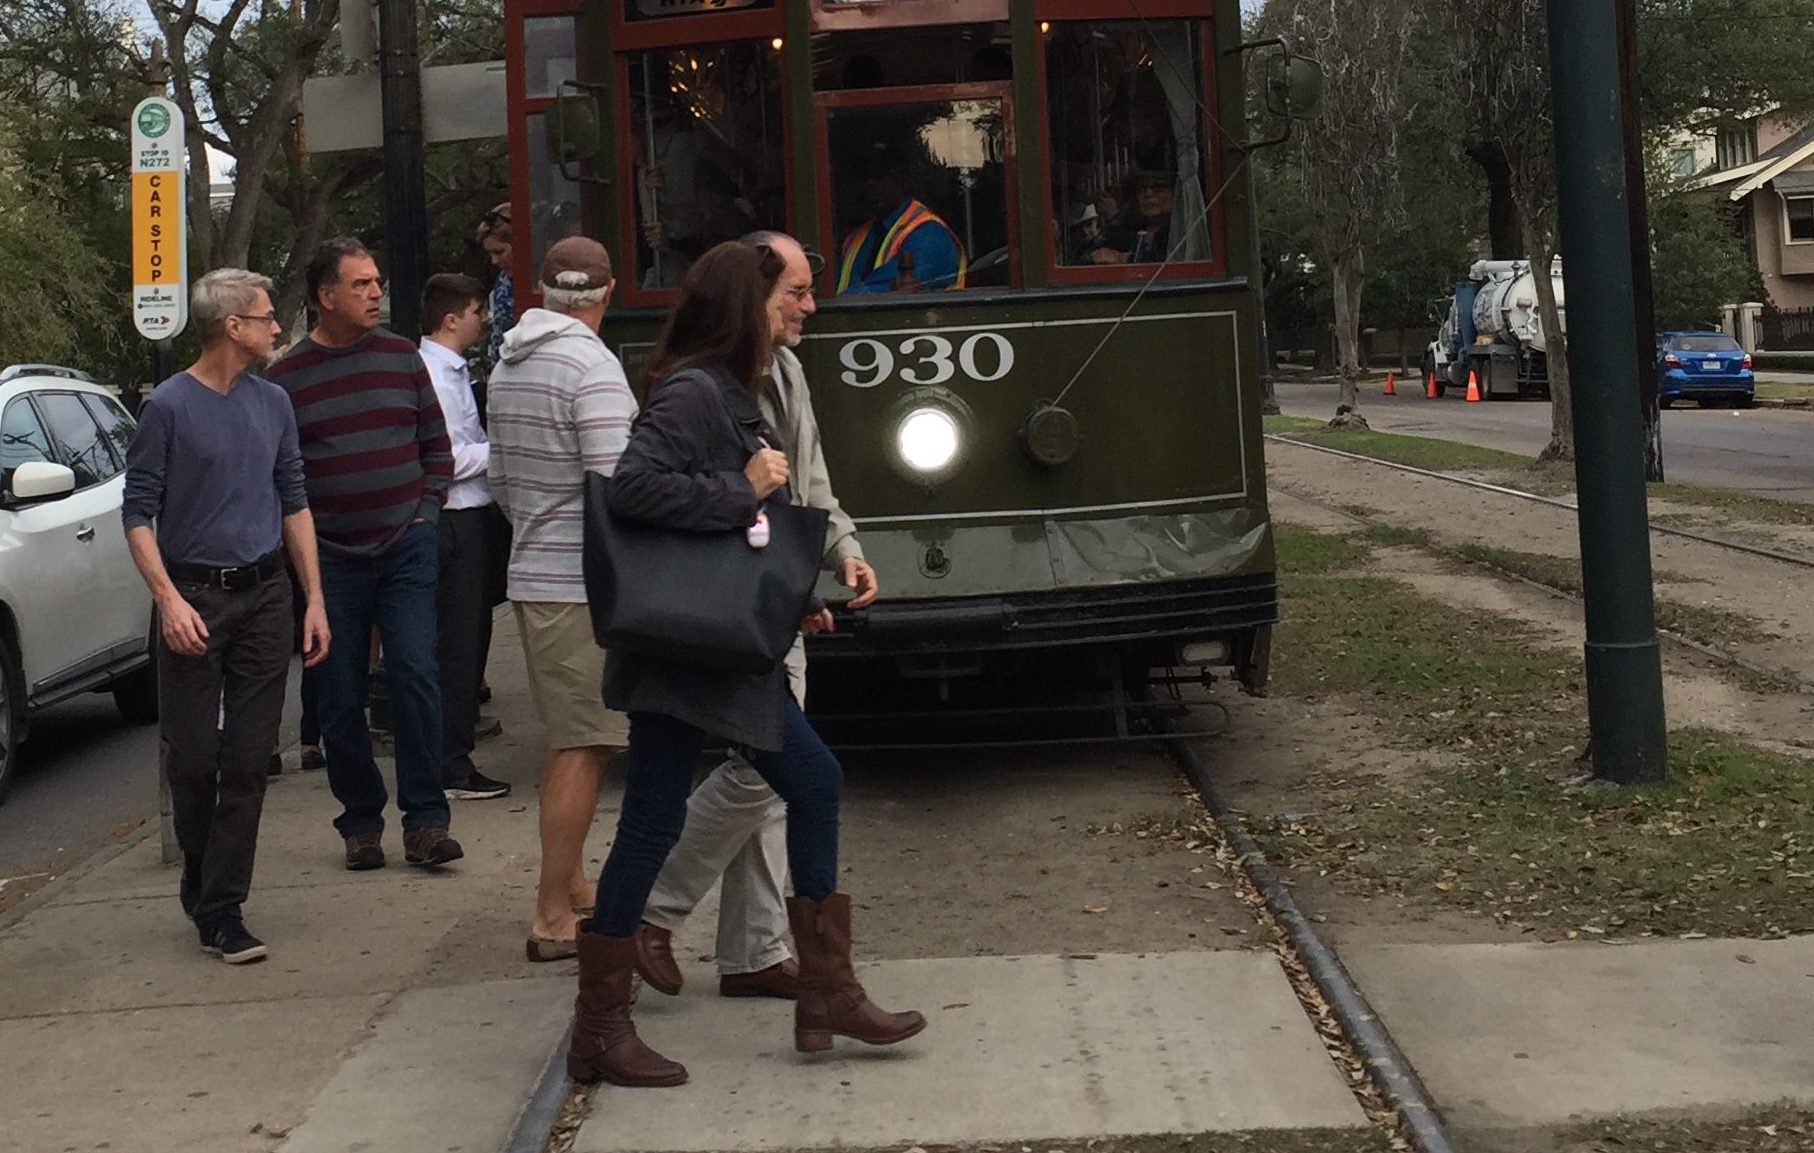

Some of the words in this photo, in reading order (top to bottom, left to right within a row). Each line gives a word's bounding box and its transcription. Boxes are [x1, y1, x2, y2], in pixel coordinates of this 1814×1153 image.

[149, 175, 161, 218] CAR
[150, 224, 162, 282] STOP
[839, 332, 1014, 388] 930
